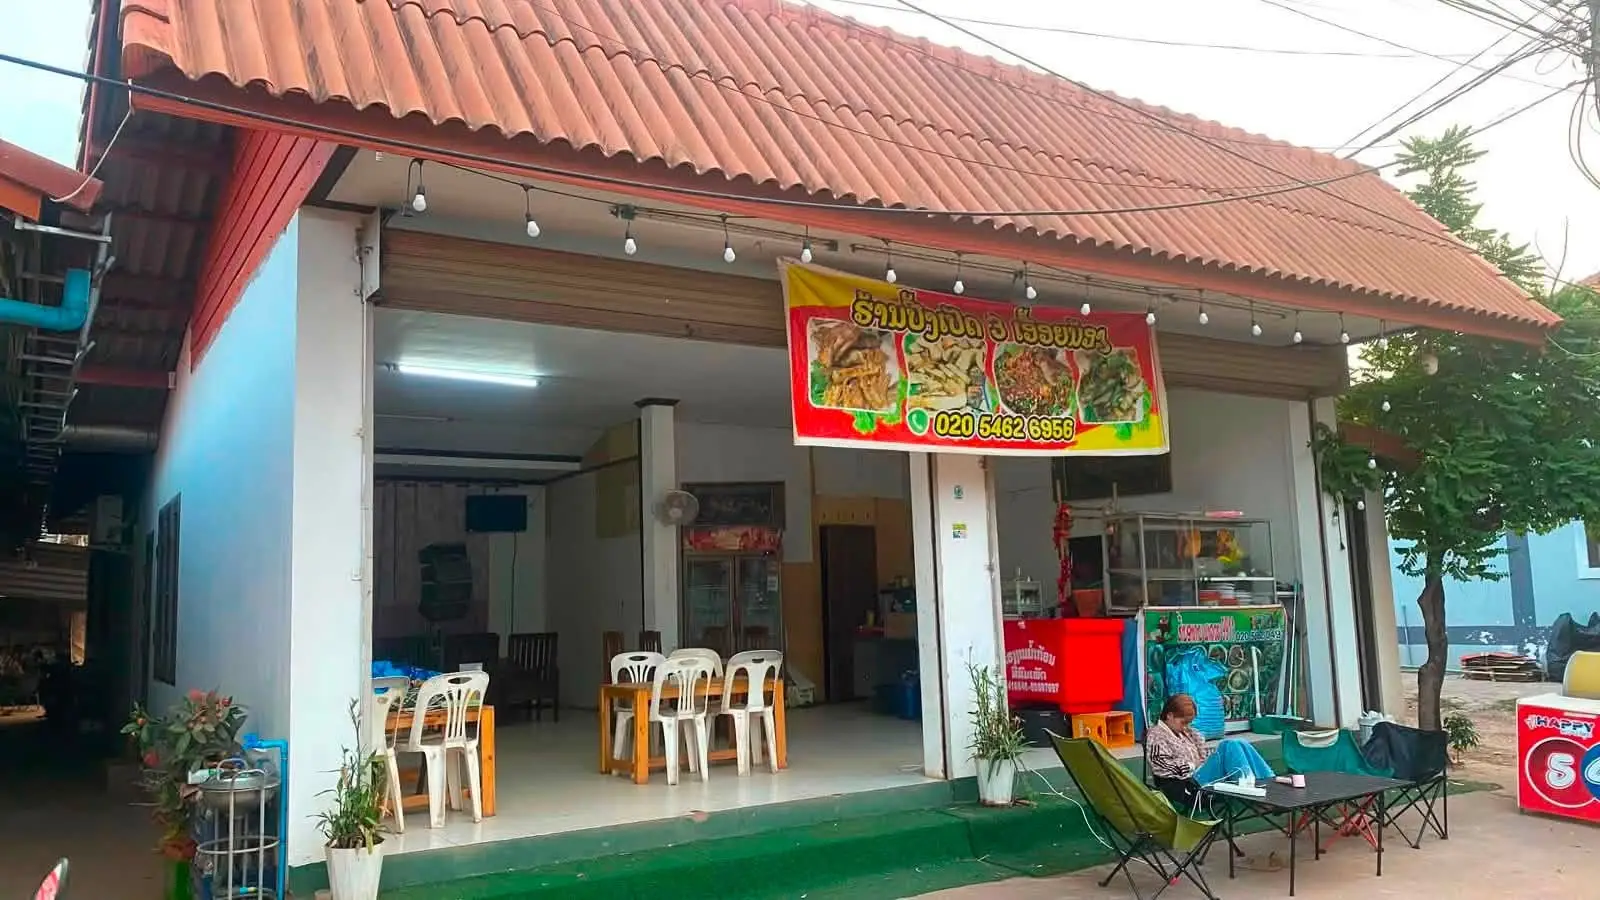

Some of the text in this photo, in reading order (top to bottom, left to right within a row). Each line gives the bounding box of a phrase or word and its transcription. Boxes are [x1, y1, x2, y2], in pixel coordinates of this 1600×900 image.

[934, 411, 1075, 440] 020 5462 6956
[1536, 716, 1594, 733] HAPPY
